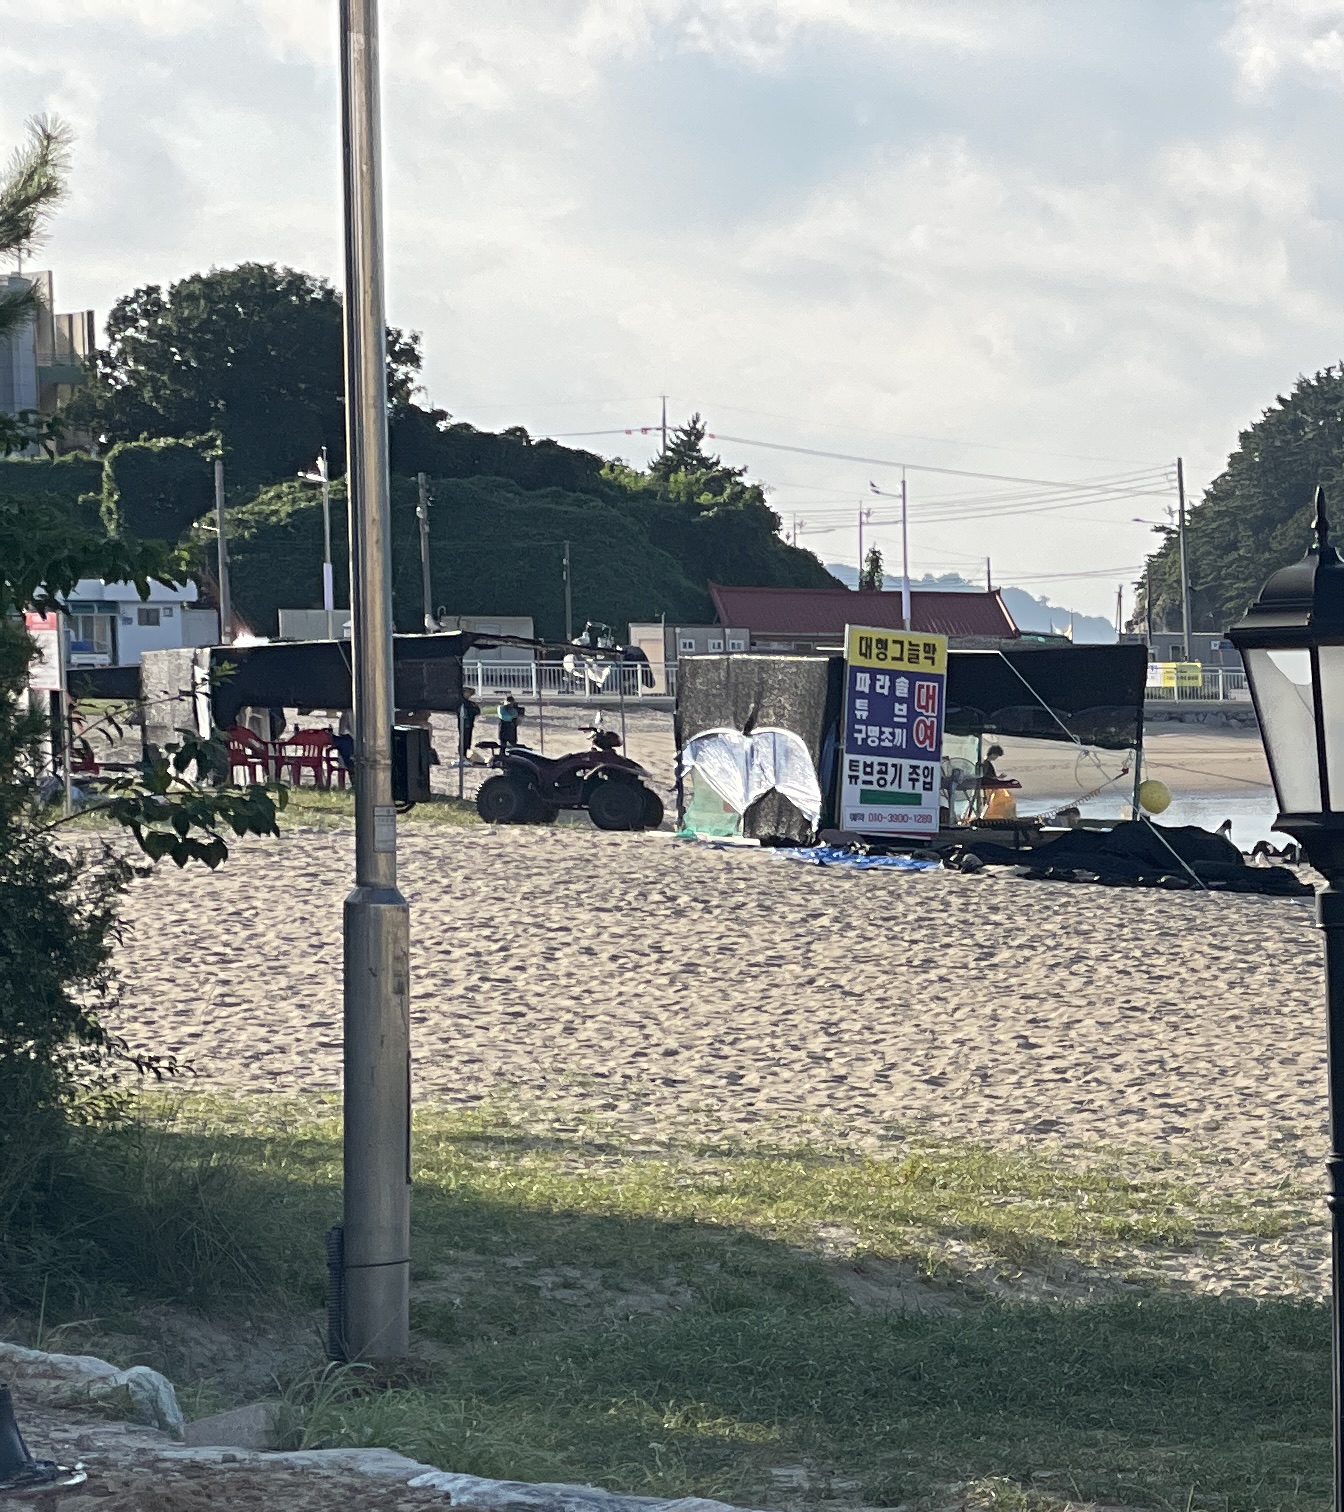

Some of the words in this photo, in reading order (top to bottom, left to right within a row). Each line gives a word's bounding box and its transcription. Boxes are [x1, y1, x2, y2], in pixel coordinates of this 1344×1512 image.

[859, 636, 937, 666] 대형그늘막
[855, 672, 910, 698] 파라솔
[914, 681, 939, 751] 대여
[853, 724, 907, 749] 구명조끼
[848, 759, 903, 789] 튜브공기
[908, 764, 935, 792] 주입
